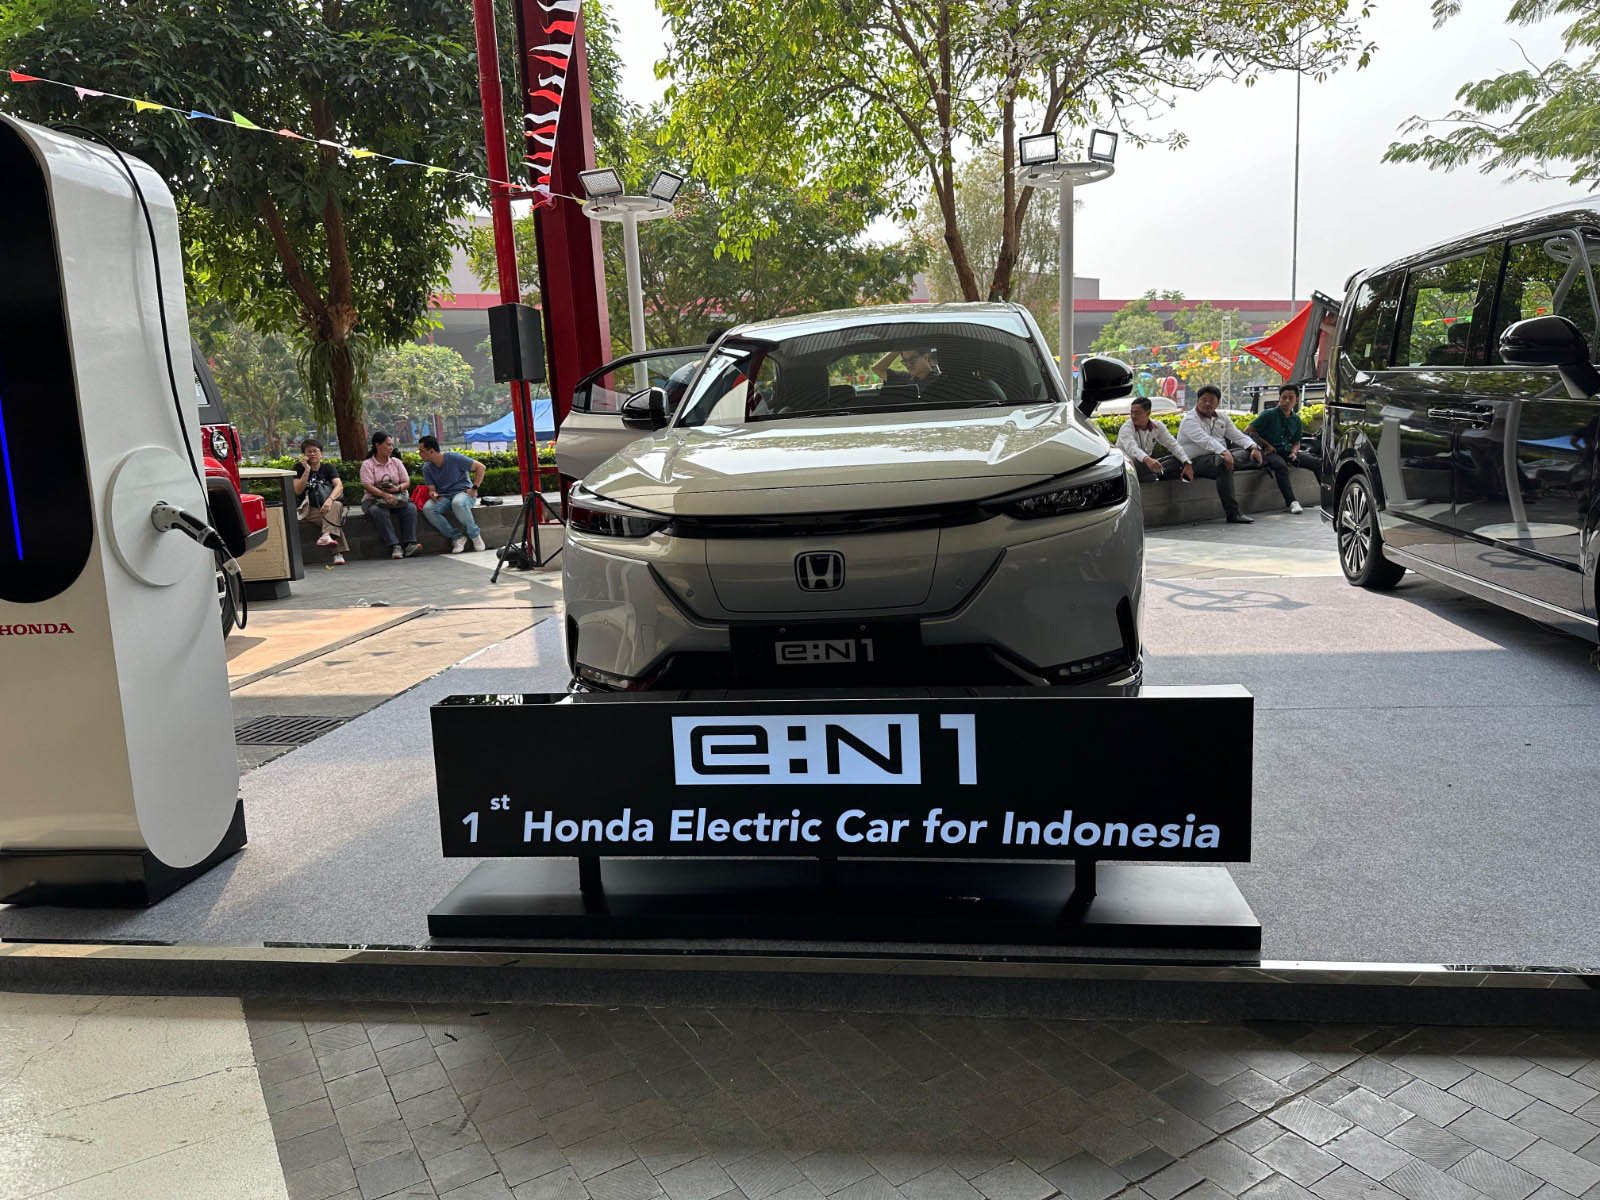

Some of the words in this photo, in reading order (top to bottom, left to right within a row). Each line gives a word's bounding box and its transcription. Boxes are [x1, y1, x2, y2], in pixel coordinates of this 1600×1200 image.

[0, 622, 74, 636] HONDA
[523, 807, 654, 842] Honda
[669, 807, 823, 842] Electric
[836, 808, 910, 843] Car
[922, 807, 988, 844] for
[1002, 810, 1220, 848] Indonesia
